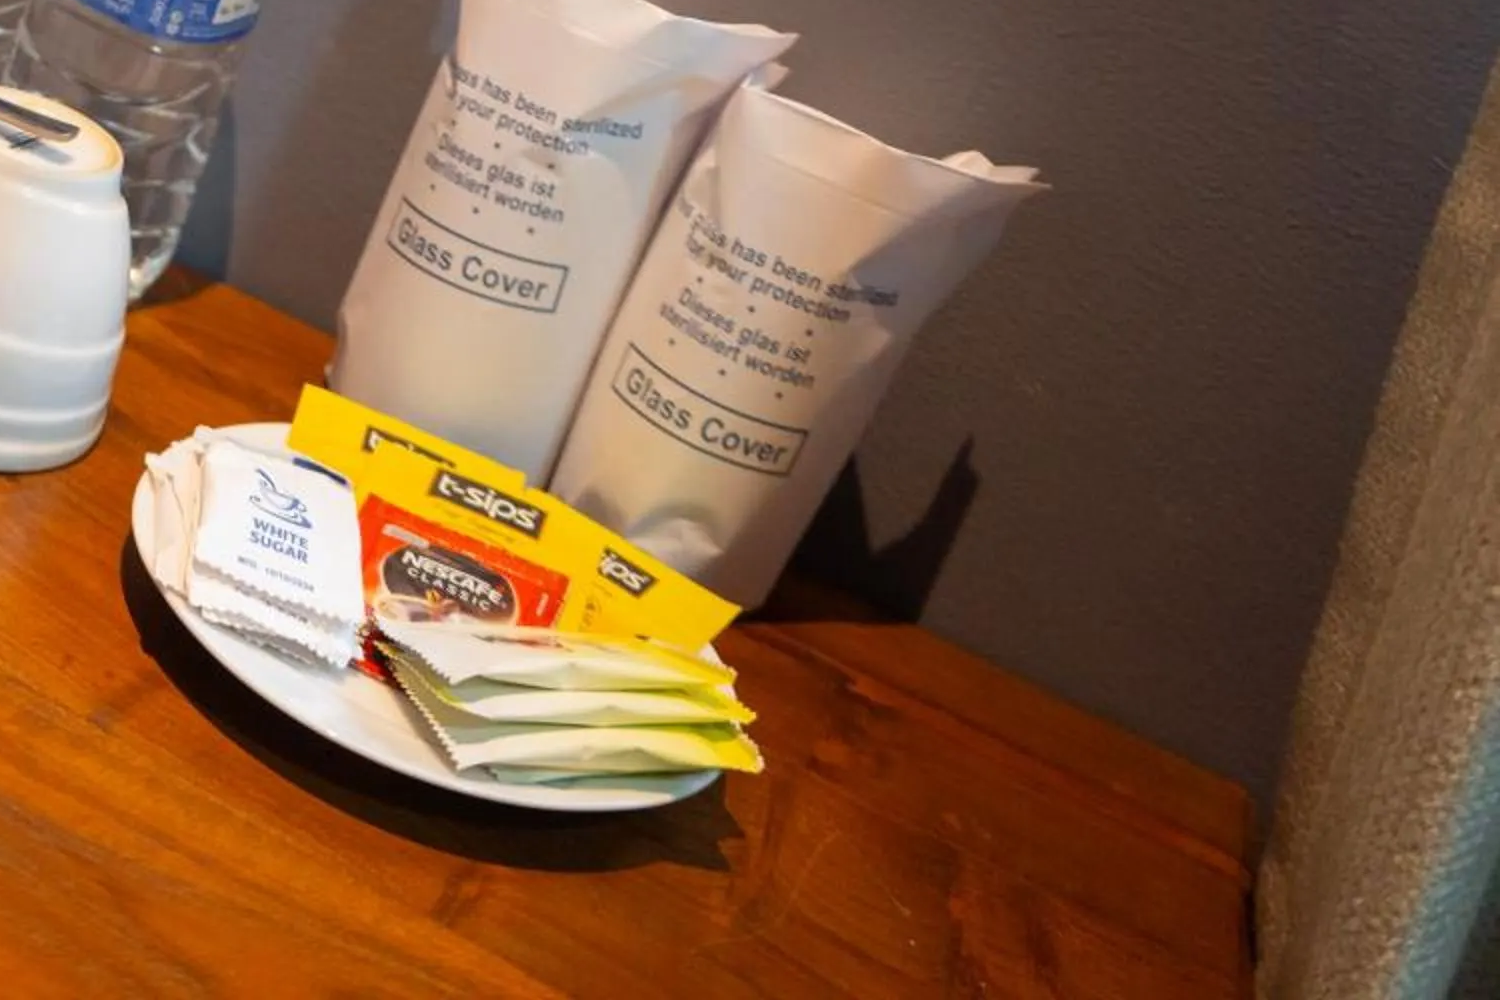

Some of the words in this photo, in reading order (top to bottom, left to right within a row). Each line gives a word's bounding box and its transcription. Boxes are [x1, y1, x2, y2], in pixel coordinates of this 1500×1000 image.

[481, 74, 512, 104] has
[513, 92, 557, 125] been
[456, 94, 496, 121] your
[495, 111, 589, 156] protection
[486, 163, 525, 190] glas
[529, 178, 556, 199] ist
[493, 191, 565, 223] worden
[398, 216, 453, 272] Glass
[461, 255, 549, 301] Cover
[730, 237, 768, 268] has
[772, 255, 821, 292] been
[705, 250, 749, 284] your
[750, 275, 851, 322] protection
[738, 326, 780, 356] glas
[784, 342, 812, 365] ist
[745, 353, 815, 388] worden
[626, 367, 692, 430] Glass
[700, 417, 789, 464] Cover
[438, 473, 541, 531] t-sips
[248, 530, 308, 564] SUGAR
[253, 516, 308, 550] WHITE
[407, 566, 491, 612] CLASSIC
